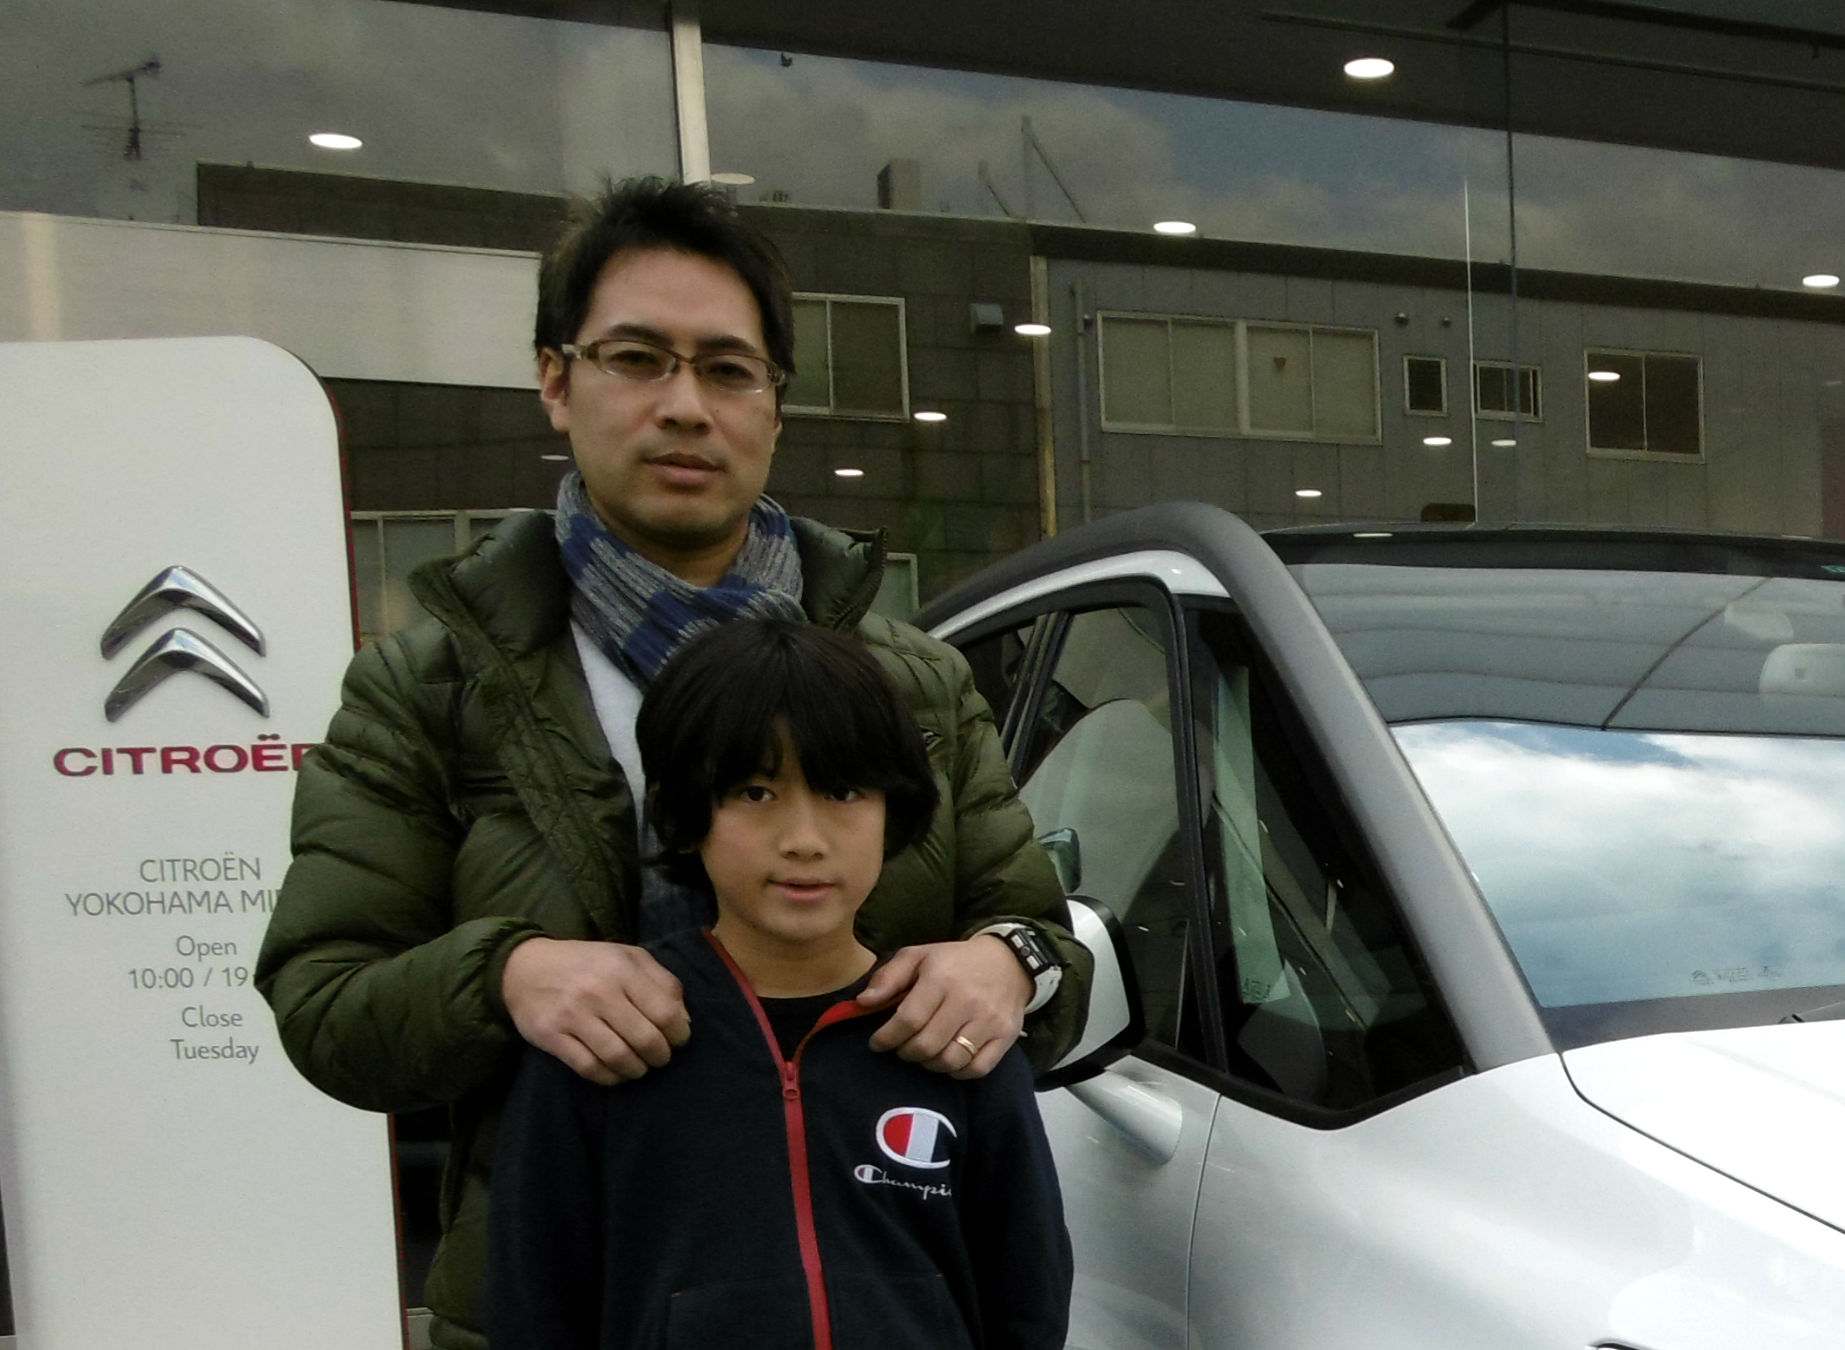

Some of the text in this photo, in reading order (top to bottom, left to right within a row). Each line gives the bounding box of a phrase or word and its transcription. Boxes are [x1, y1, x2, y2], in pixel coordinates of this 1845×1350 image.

[139, 851, 261, 883] CITROËN
[65, 890, 233, 916] YOKOHAMA
[176, 935, 238, 962] Open
[128, 966, 254, 989] 10:00 / 19
[181, 1005, 243, 1028] Close
[170, 1037, 259, 1064] Tuesday
[854, 1164, 952, 1200] Champi
